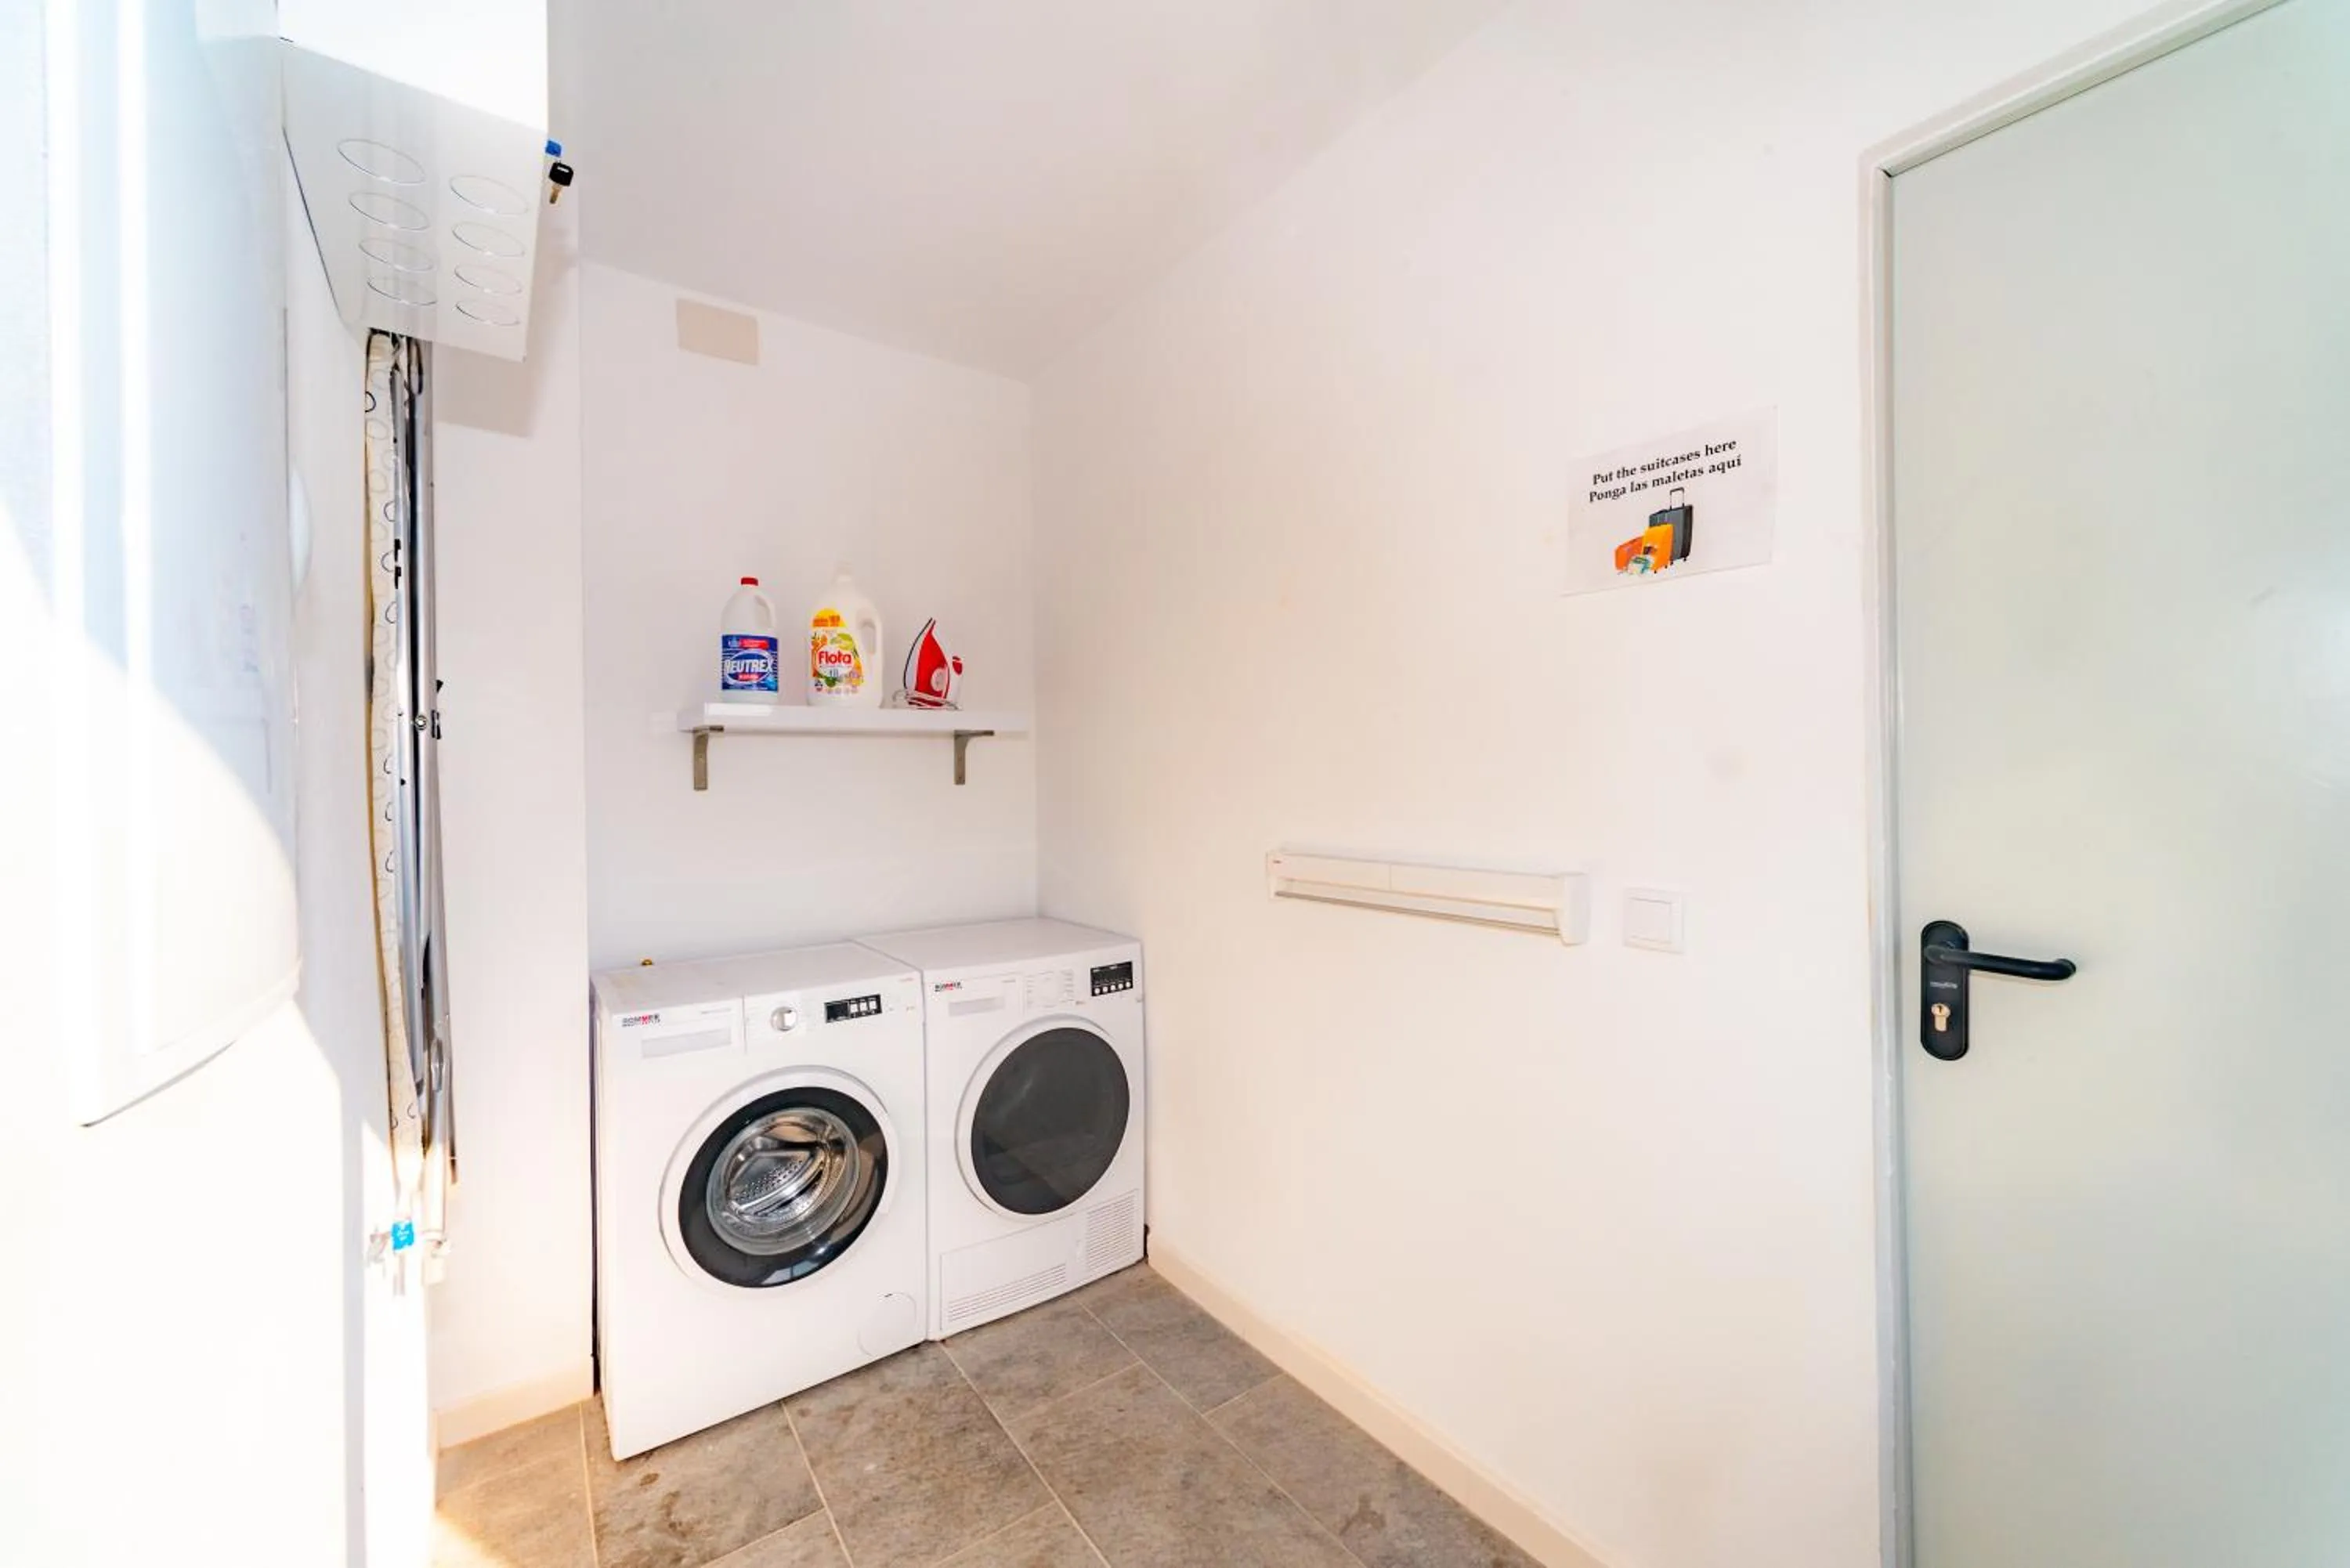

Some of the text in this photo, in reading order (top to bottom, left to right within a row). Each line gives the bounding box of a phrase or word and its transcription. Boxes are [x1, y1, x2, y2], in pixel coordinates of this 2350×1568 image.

[1589, 454, 1741, 502] Ponga las maletas aquí
[1593, 440, 1737, 485] Put the suitcases here
[818, 651, 851, 664] Flota
